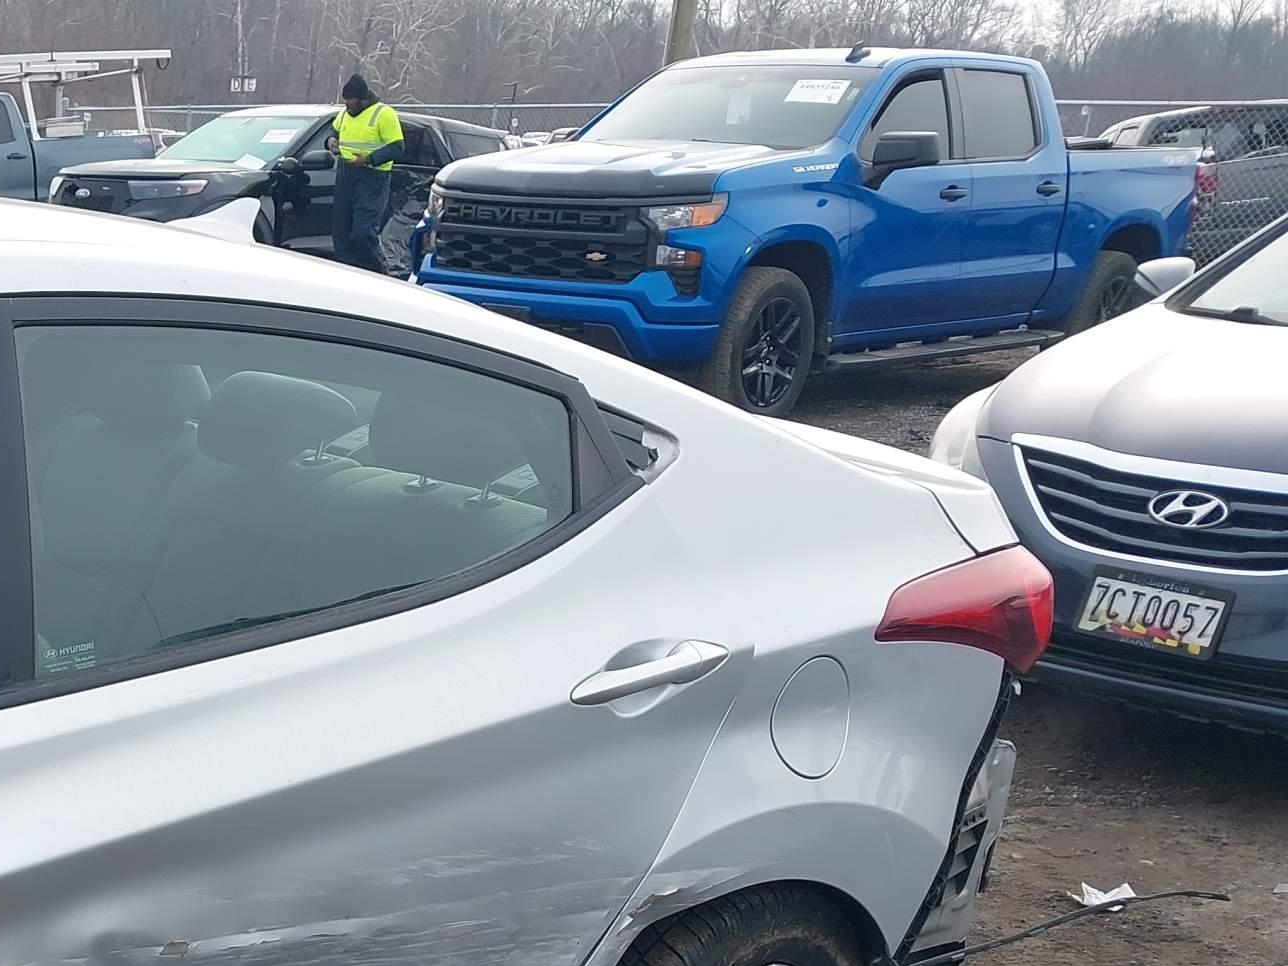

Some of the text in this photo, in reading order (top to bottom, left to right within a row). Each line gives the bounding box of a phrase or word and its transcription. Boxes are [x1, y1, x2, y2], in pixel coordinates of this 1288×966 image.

[445, 202, 625, 228] CHEVROLET
[1088, 583, 1220, 639] 7CT0057
[59, 642, 95, 656] HYUNDAI
